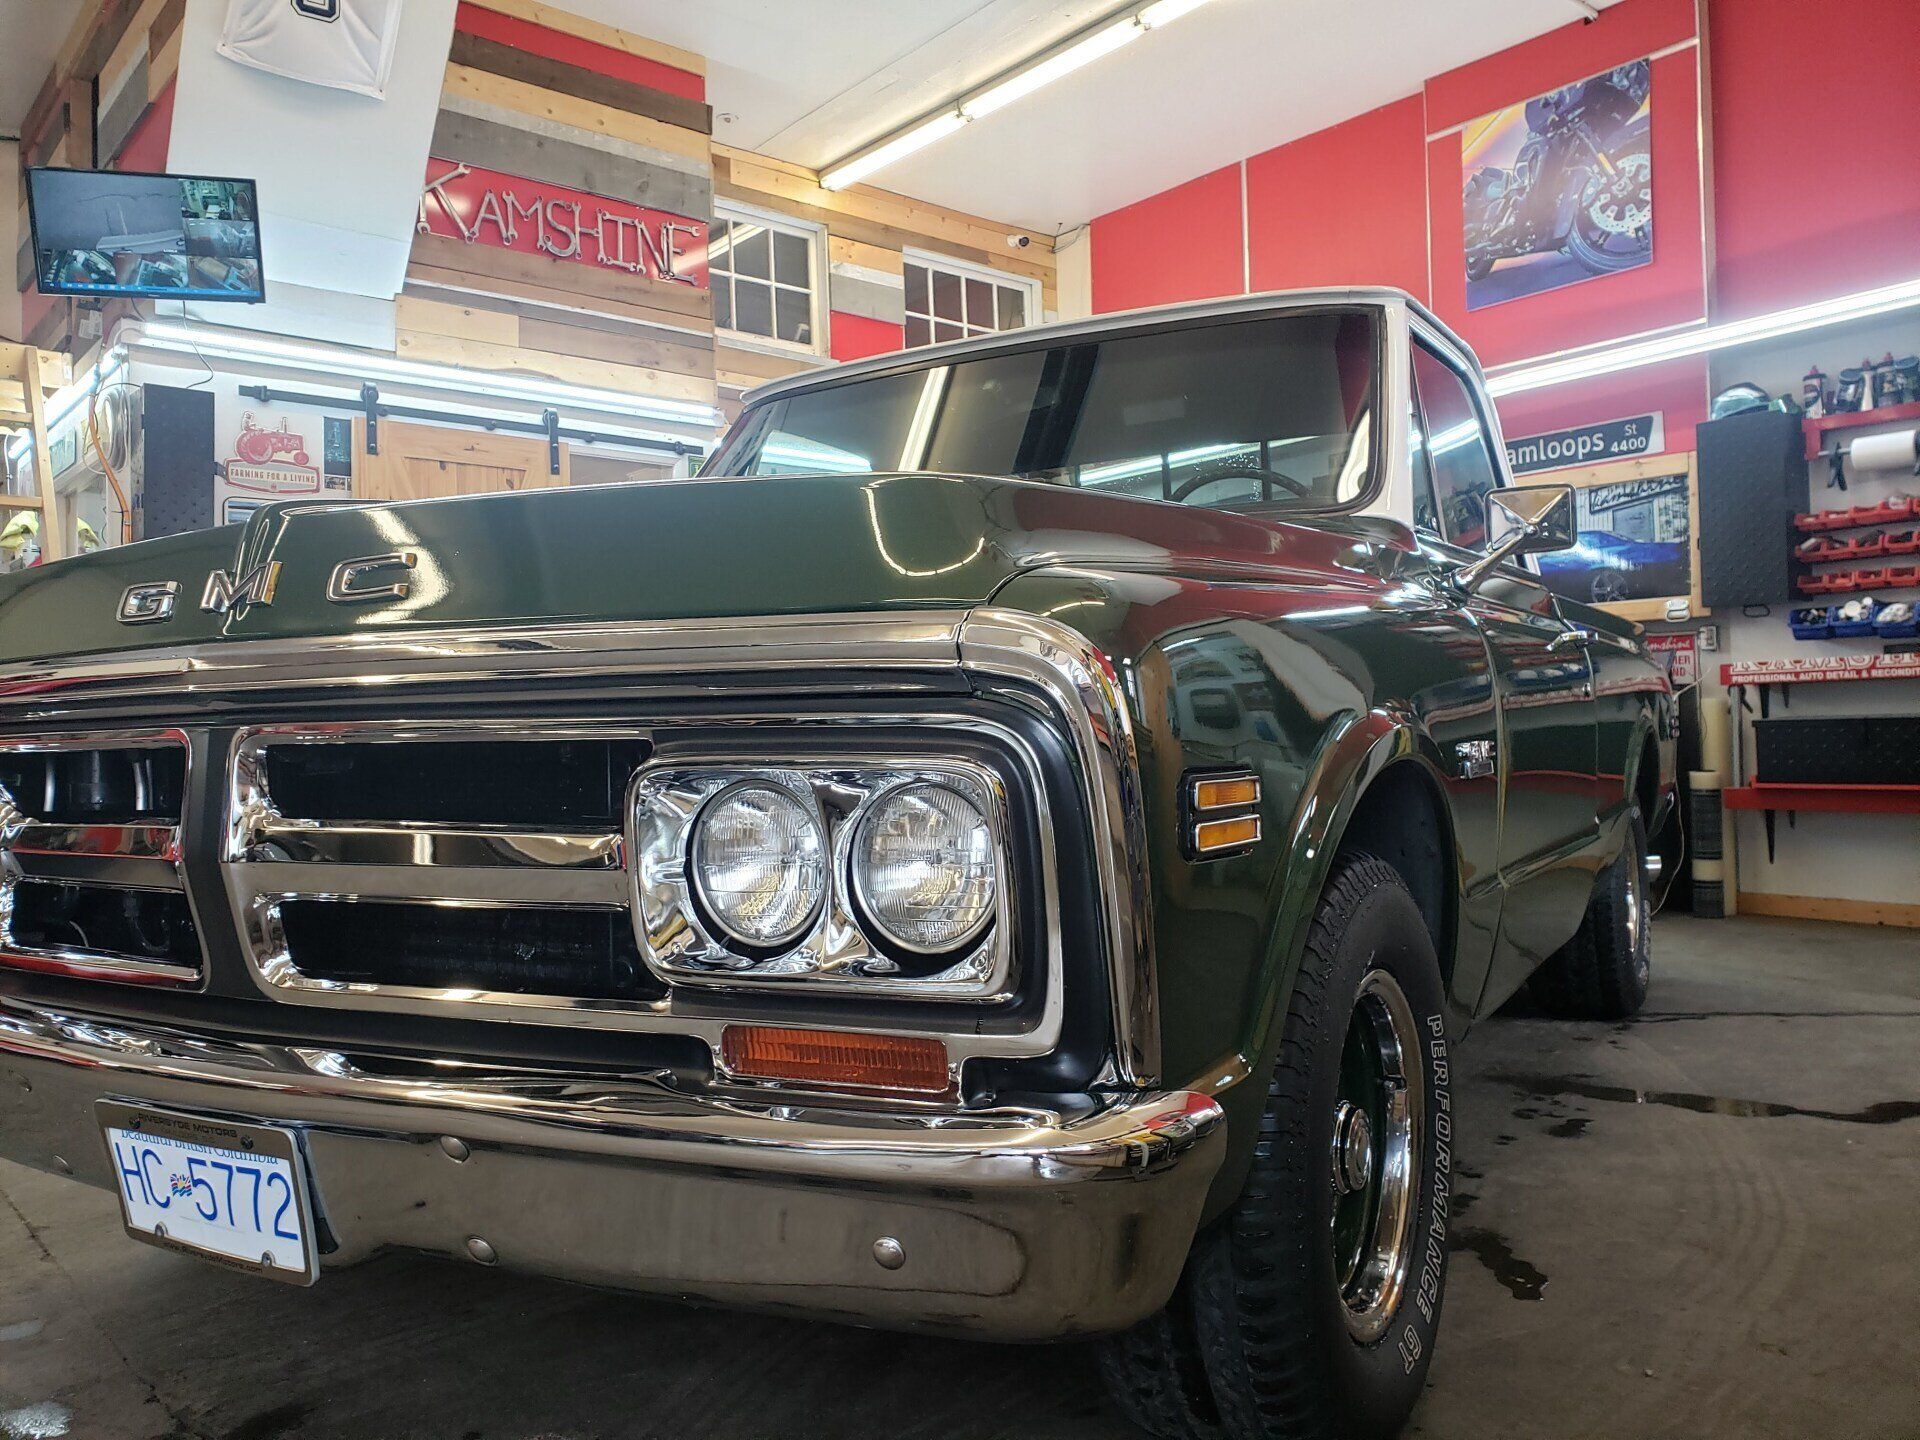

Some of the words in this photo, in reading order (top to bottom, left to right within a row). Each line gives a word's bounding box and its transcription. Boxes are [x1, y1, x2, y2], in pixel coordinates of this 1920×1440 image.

[417, 162, 700, 285] KAMSHINE
[1508, 433, 1604, 465] amloops
[1624, 423, 1637, 436] St
[1611, 437, 1646, 453] 4400
[231, 469, 264, 479] FARMING
[267, 472, 280, 480] FOR
[290, 474, 315, 483] LIVING
[116, 552, 418, 625] GMC
[1732, 673, 1796, 684] PROFESSIONAL
[1799, 671, 1824, 681] AUTO
[1826, 669, 1859, 680] DETAIL
[192, 1122, 238, 1138] MOTORS
[1416, 1014, 1450, 1324] PERFORMANCE
[187, 1157, 298, 1240] 5772
[1398, 1325, 1421, 1375] GT
